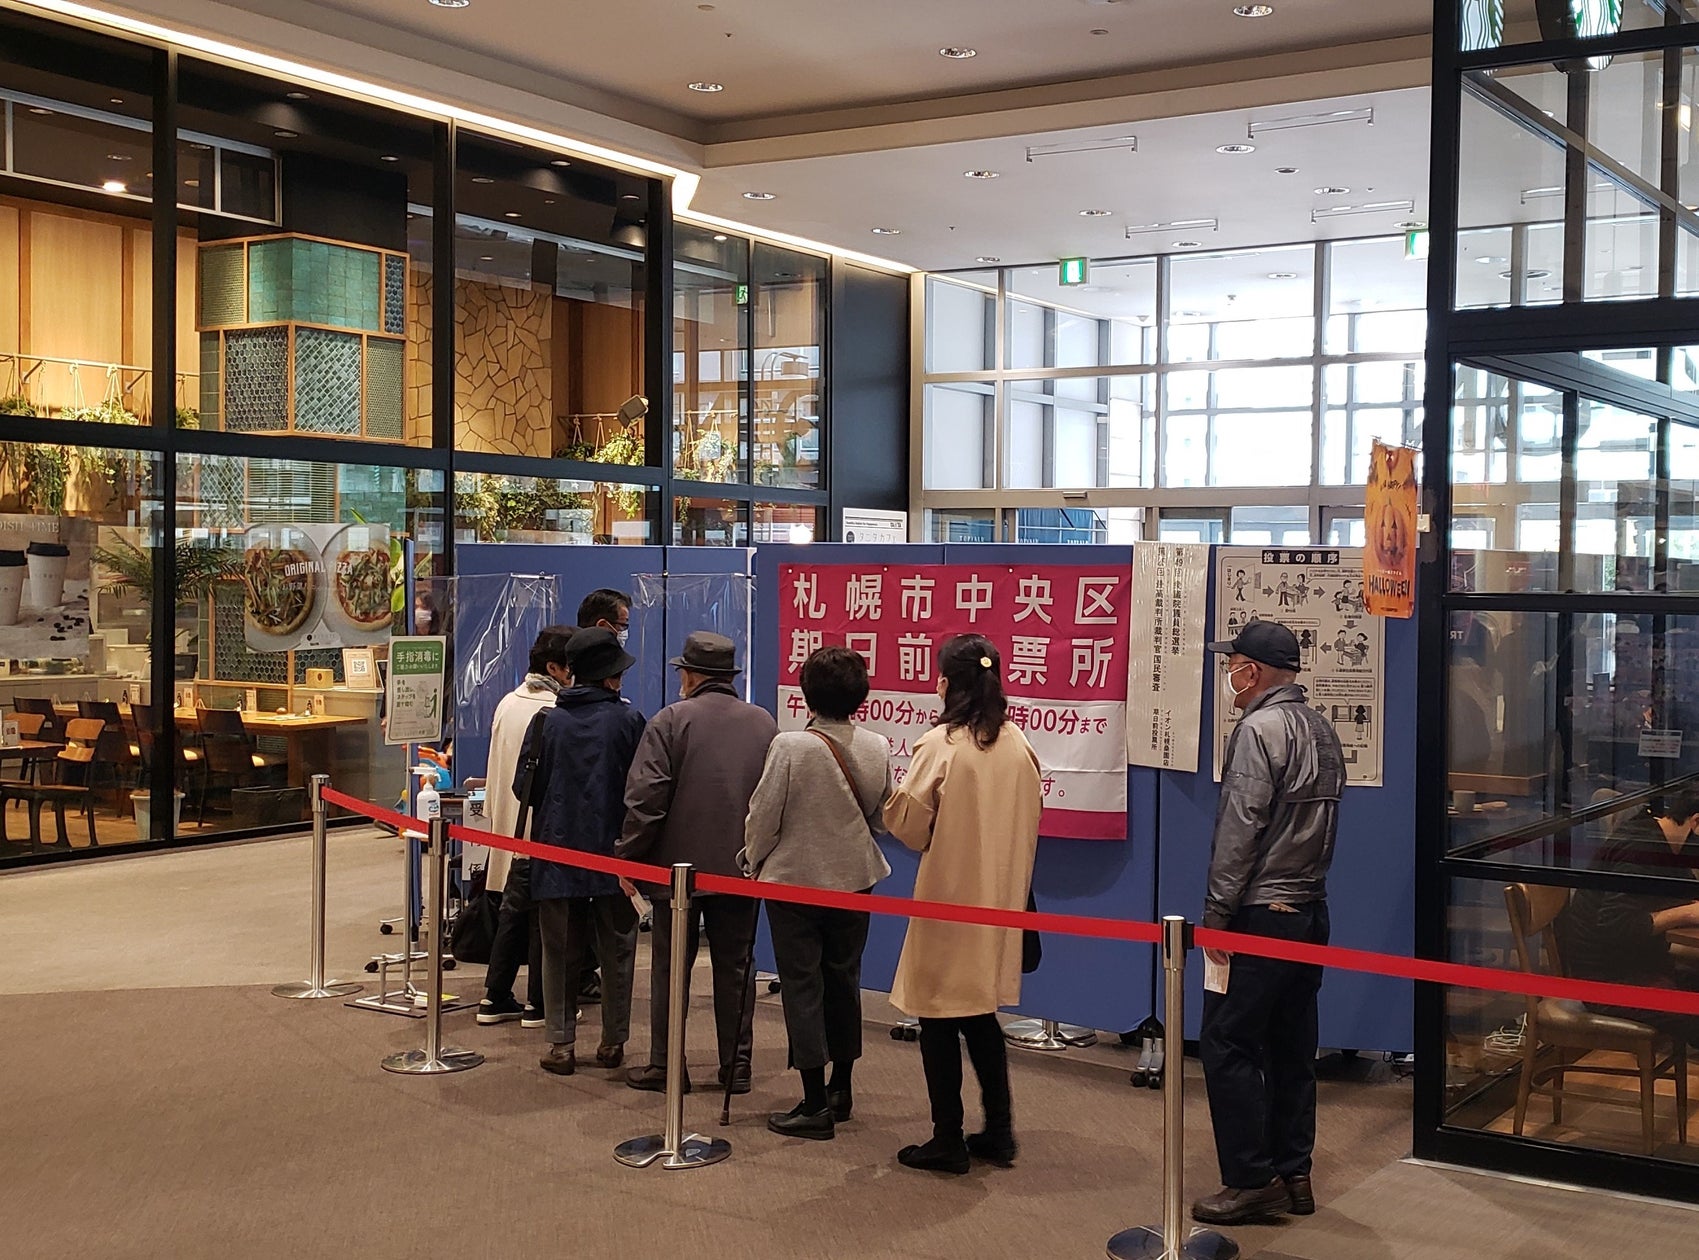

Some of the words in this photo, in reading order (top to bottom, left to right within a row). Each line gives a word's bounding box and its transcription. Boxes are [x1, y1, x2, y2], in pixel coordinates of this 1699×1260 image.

[1263, 552, 1339, 564] 投票の順序
[284, 561, 326, 577] ORIGINAL
[1368, 574, 1411, 599] HALLOWEEN
[792, 572, 1120, 626] 札幌市中央区
[396, 650, 440, 663] 手指消毒に
[788, 629, 1115, 689] 期日前票所
